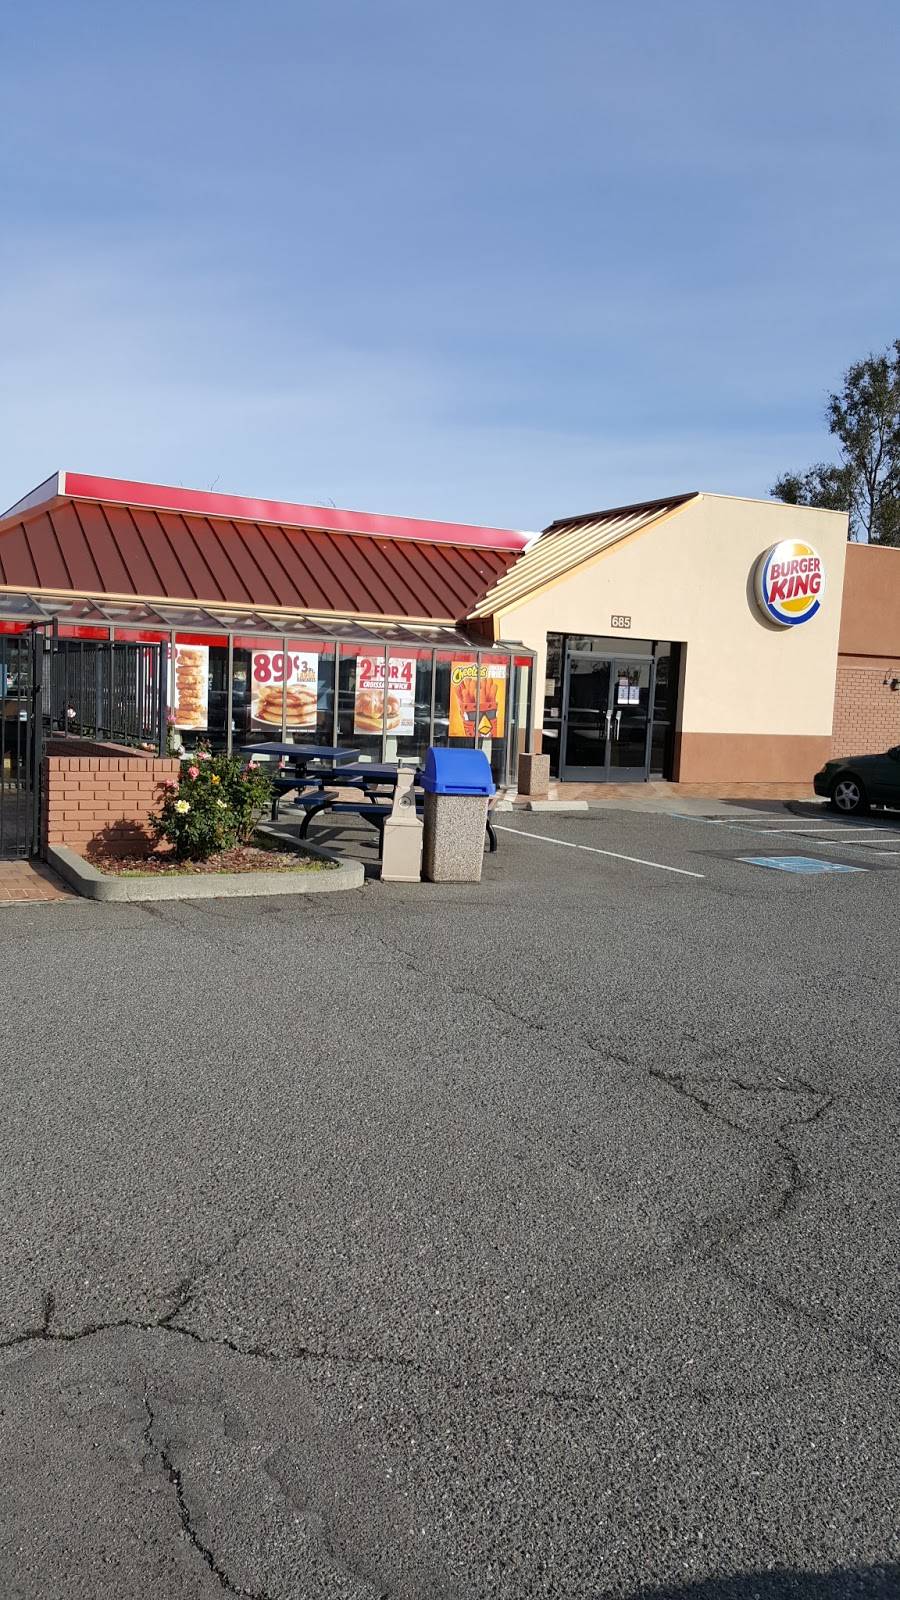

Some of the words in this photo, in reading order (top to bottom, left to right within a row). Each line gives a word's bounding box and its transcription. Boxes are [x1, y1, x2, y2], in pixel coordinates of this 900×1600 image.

[770, 558, 820, 581] BURGER
[769, 573, 821, 603] KING
[612, 616, 630, 628] 685
[360, 659, 371, 680] 2
[374, 665, 398, 678] FOR
[363, 681, 408, 690] CROISSN'WICH
